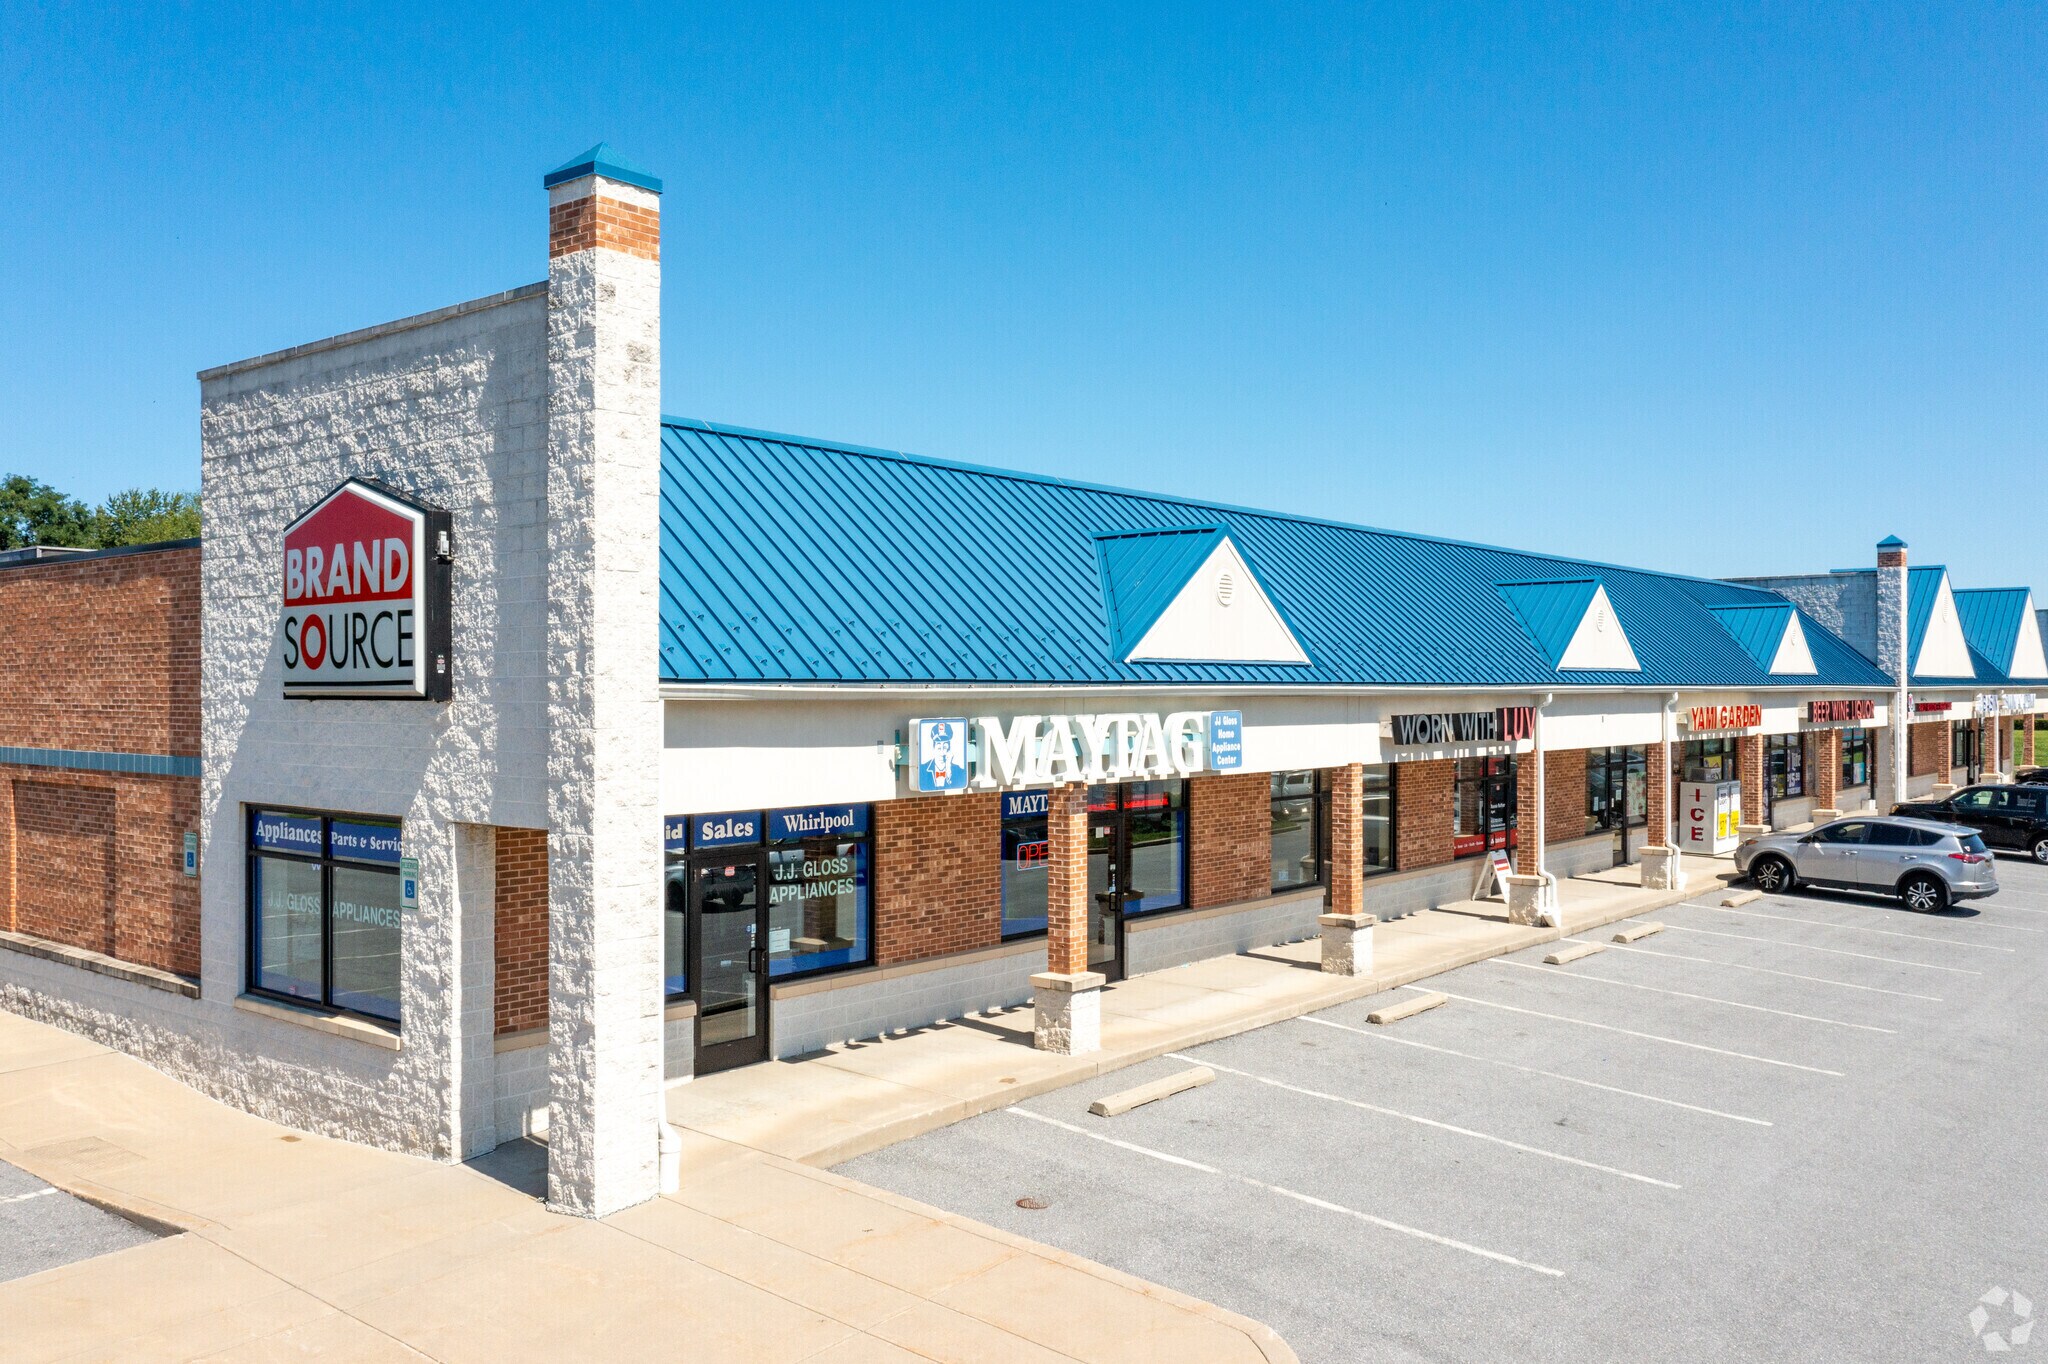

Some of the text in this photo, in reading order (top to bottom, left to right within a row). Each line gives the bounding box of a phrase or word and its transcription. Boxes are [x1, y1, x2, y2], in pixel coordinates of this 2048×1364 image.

[286, 537, 410, 600] BRAND
[284, 609, 413, 671] SOURCE
[1223, 715, 1237, 726] Gloss
[1691, 704, 1762, 731] YAMI GARDEN
[1813, 700, 1874, 722] BEER WINE LIQUOR
[1218, 729, 1235, 739] Home
[1400, 706, 1537, 745] WORN WITH LUV
[973, 712, 1204, 789] MAYTAG
[1212, 741, 1241, 754] Appliance
[1217, 755, 1237, 765] Center
[1008, 794, 1049, 815] MAYT
[1690, 788, 1705, 841] ICE
[256, 820, 321, 844] Appliances
[702, 818, 754, 841] Sales
[783, 809, 854, 834] Whirlpool
[331, 831, 357, 847] Parts
[360, 836, 367, 848] &
[775, 857, 848, 881] J.J. GLOSS
[769, 878, 854, 904] APPLIANCES
[268, 891, 401, 929] J.J. GLOSS APPLIANCES
